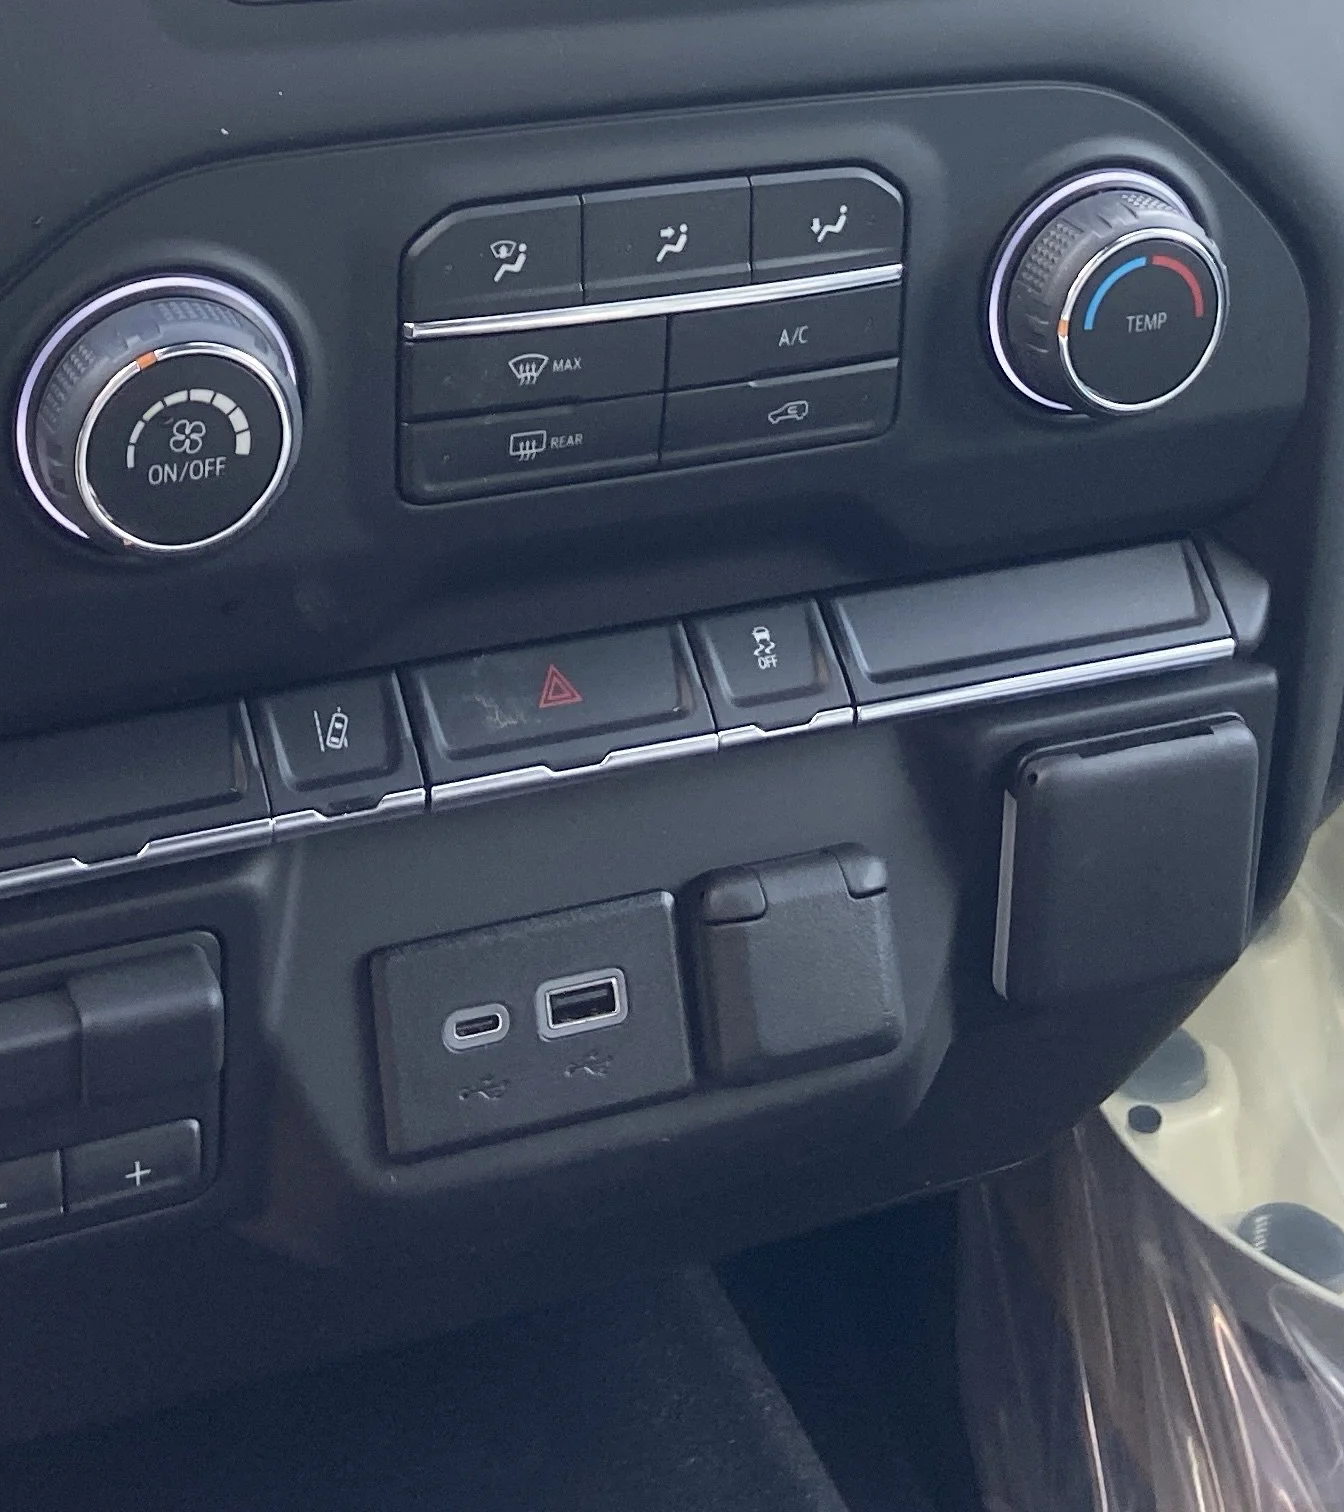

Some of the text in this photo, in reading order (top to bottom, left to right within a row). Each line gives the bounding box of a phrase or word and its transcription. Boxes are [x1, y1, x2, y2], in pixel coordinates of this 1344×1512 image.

[1126, 312, 1167, 333] TEMP
[778, 326, 809, 347] A/C
[552, 357, 582, 373] MAX
[550, 434, 583, 449] REAR
[148, 457, 227, 485] ON/OFF
[758, 654, 777, 669] OFF
